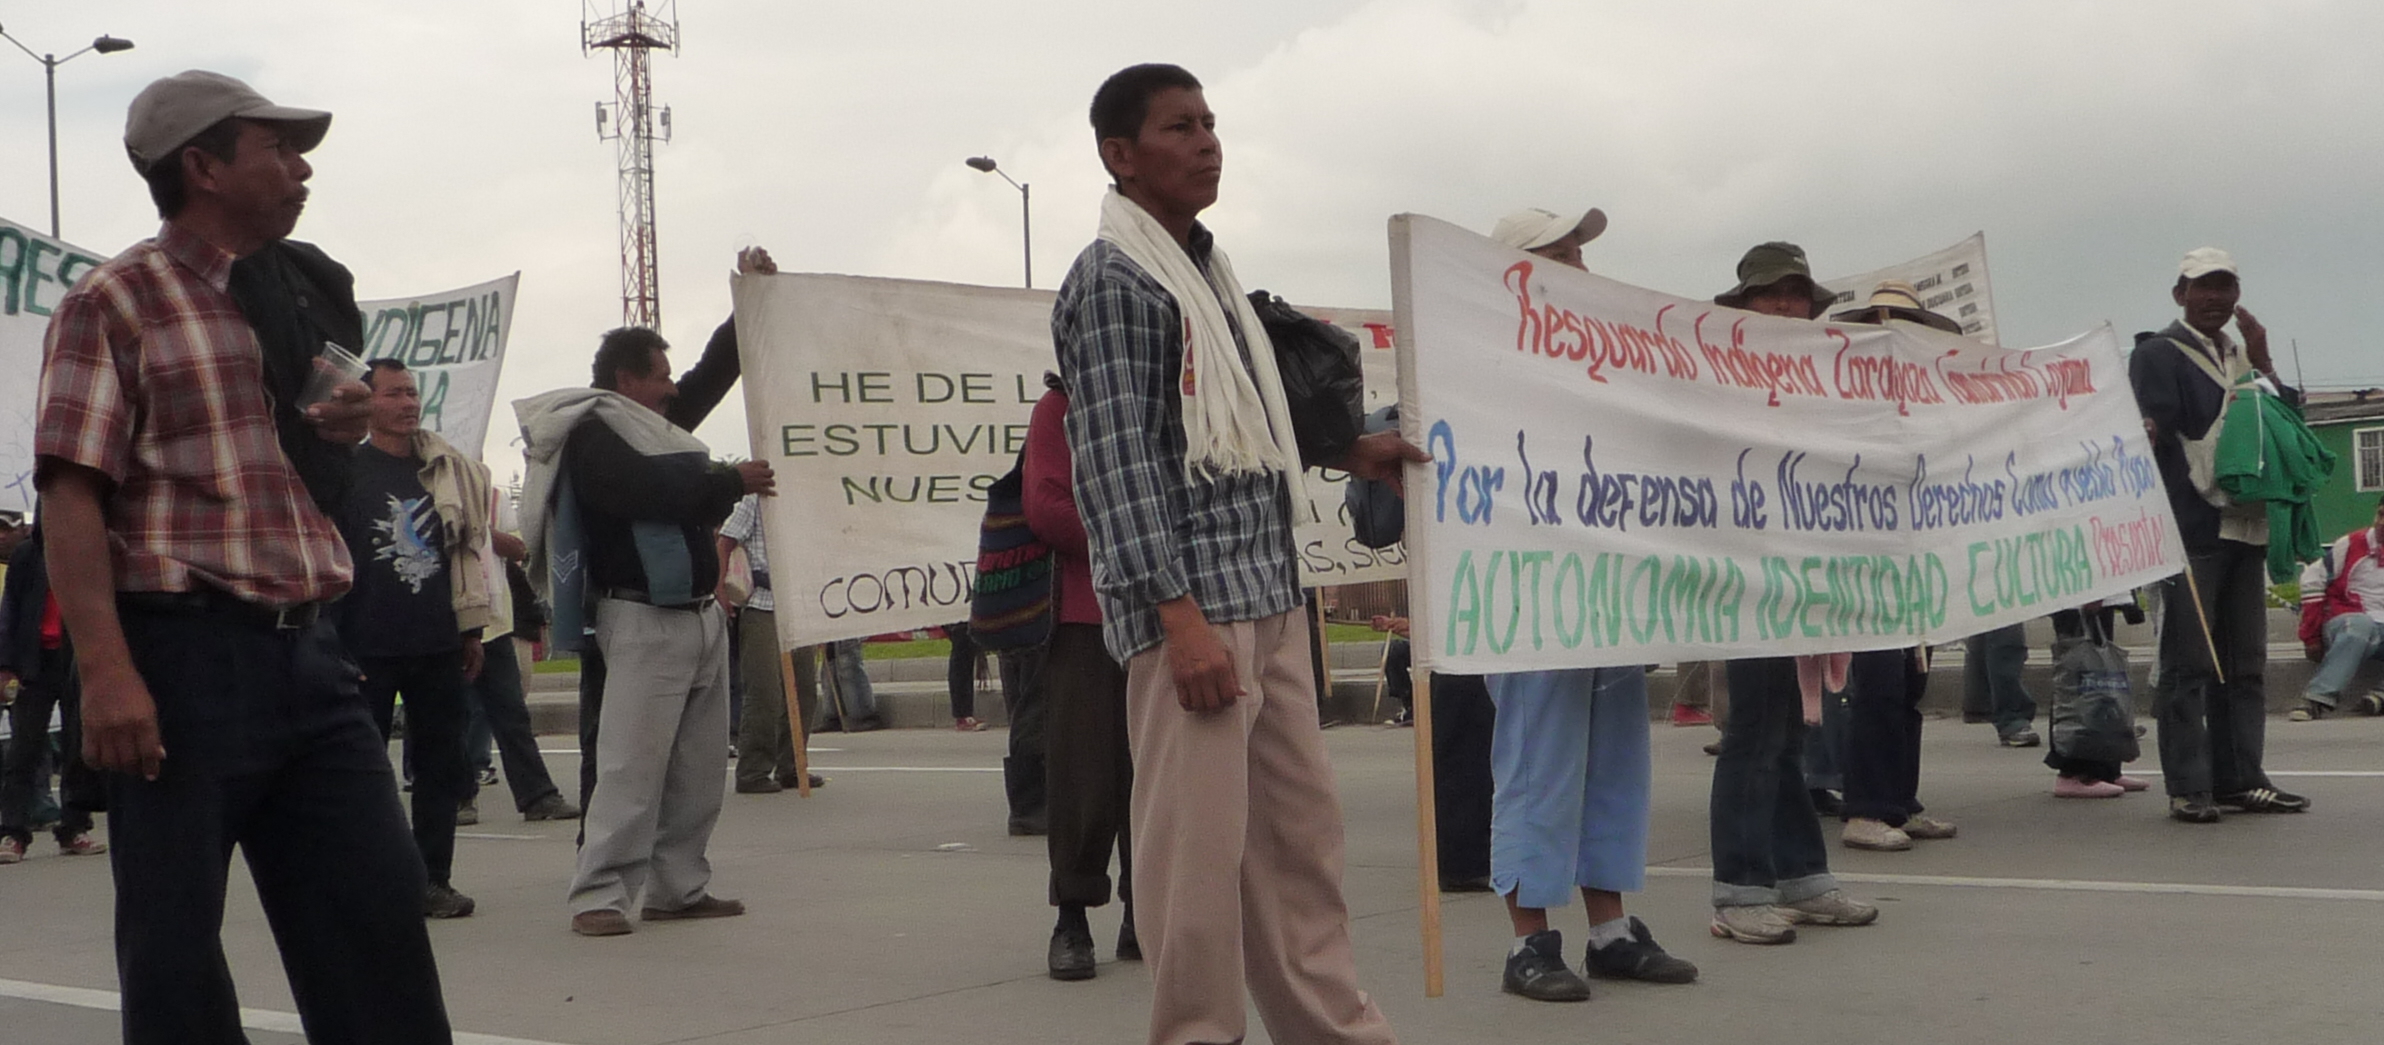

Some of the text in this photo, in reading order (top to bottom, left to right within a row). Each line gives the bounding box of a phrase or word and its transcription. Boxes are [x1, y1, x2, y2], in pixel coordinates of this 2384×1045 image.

[811, 371, 894, 403] HE
[916, 372, 996, 403] DE
[1428, 419, 1504, 526] Por
[1517, 430, 1562, 526] la
[1731, 447, 1768, 530] de
[1778, 449, 1898, 532] Nuestros
[1909, 453, 2006, 531] Derechos
[1446, 549, 1747, 657] AUTONOMIA
[1755, 552, 1949, 640] IDENTIDAD
[1967, 523, 2094, 618] CULTURA
